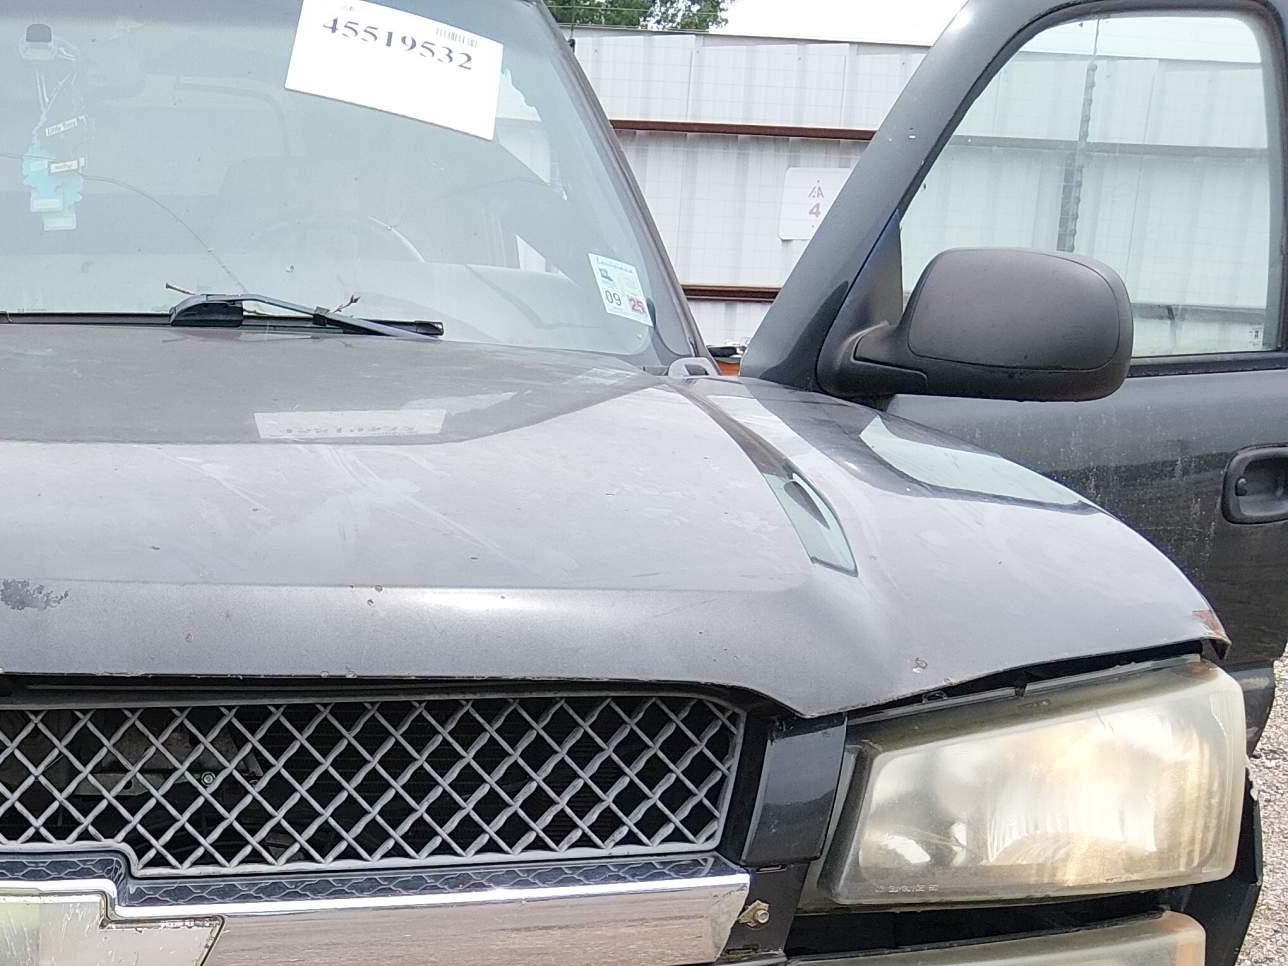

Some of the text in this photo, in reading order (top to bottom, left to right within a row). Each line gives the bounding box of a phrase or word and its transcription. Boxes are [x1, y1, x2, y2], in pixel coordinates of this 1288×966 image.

[322, 17, 473, 70] 45519532
[808, 202, 821, 218] 4
[605, 289, 621, 306] 09
[628, 297, 647, 315] 25
